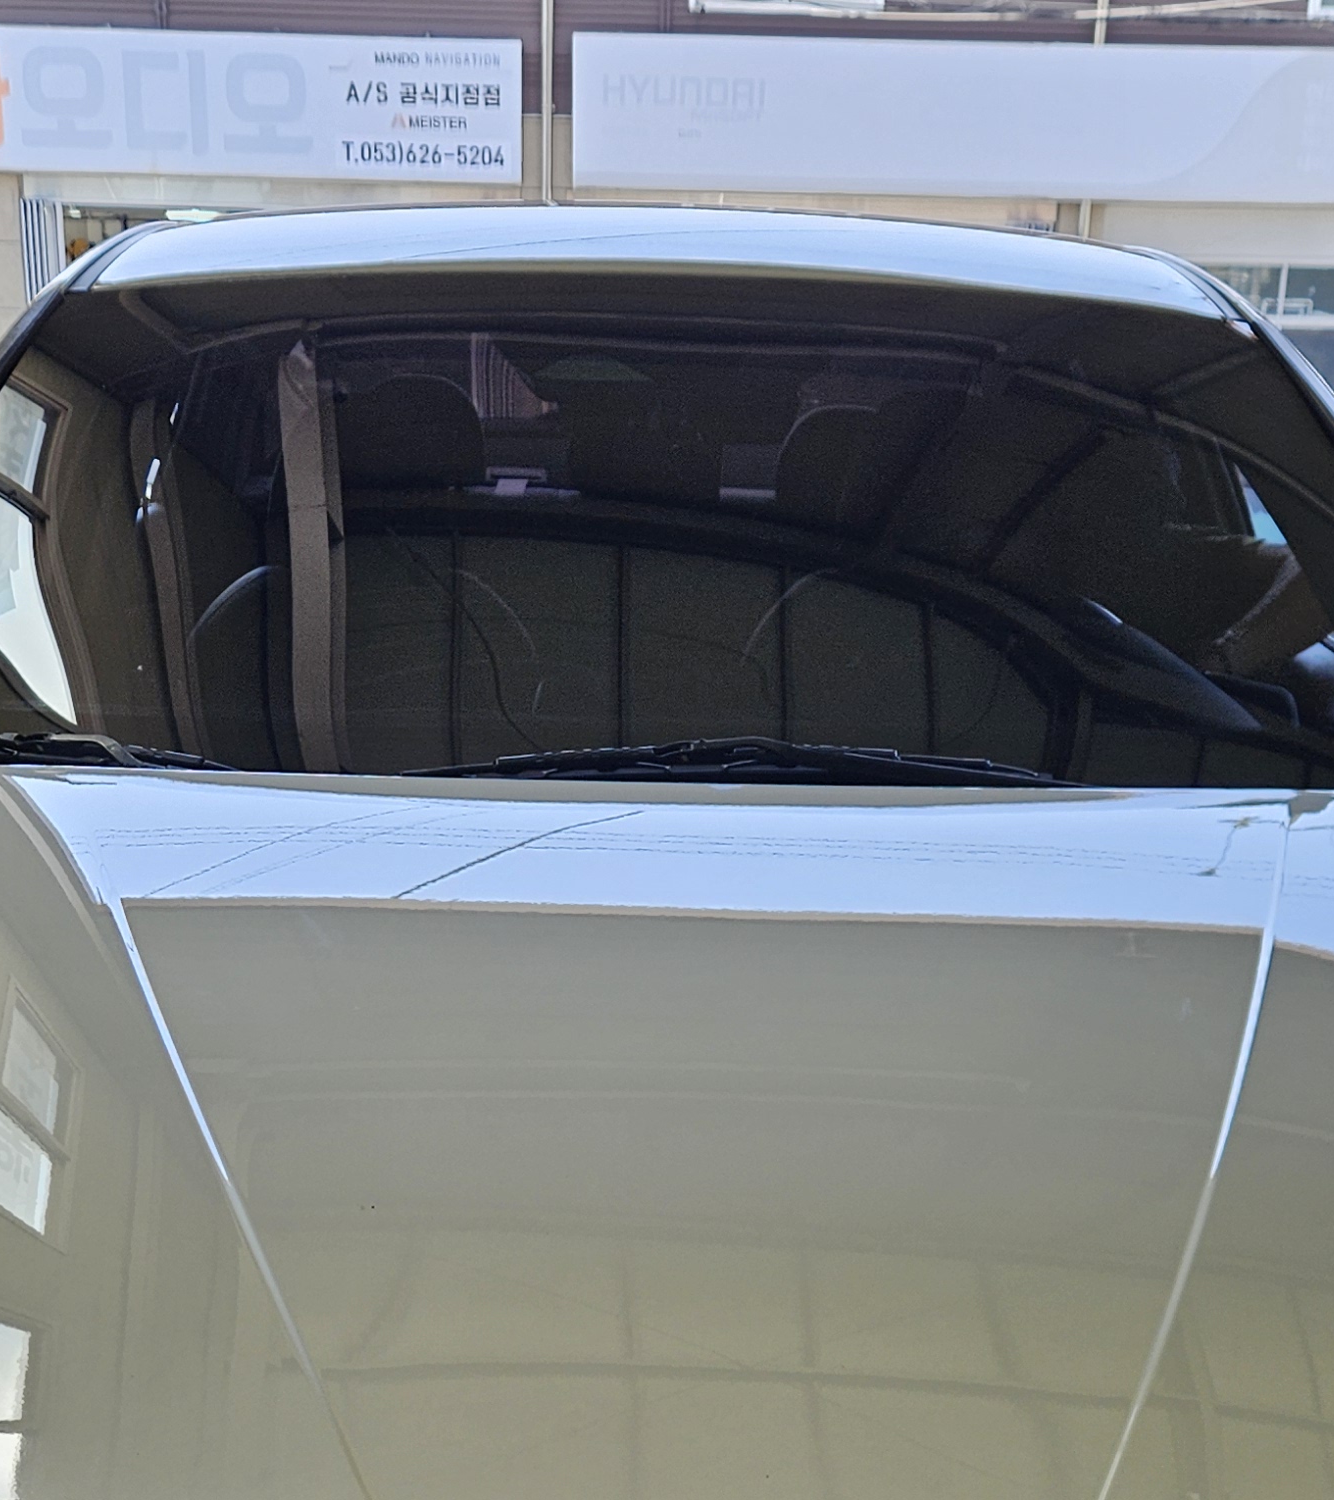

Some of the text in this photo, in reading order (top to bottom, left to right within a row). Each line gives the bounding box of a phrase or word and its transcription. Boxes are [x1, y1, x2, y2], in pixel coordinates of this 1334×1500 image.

[374, 51, 501, 67] MANDO NAVIGATION
[346, 80, 389, 105] A/S
[601, 73, 766, 107] HYUNDAI
[408, 114, 468, 130] MEISTER
[342, 140, 505, 167] T.053)626-5204
